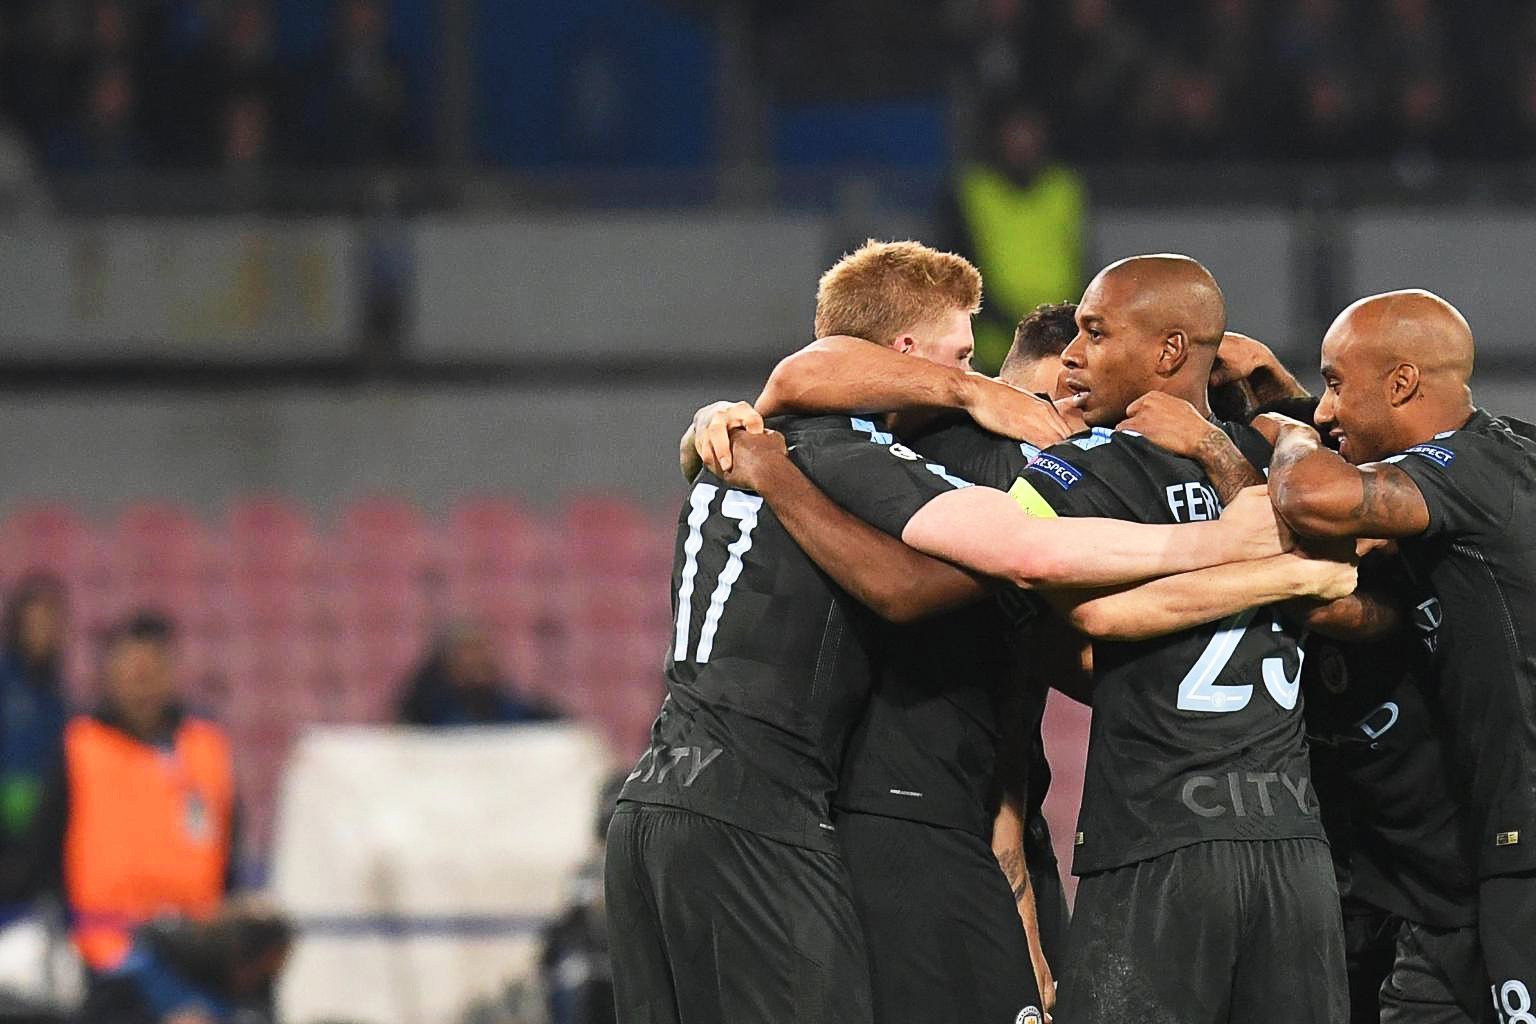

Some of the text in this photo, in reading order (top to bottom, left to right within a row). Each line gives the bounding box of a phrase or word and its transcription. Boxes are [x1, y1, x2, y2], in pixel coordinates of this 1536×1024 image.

[1033, 457, 1078, 485] RESPECT
[673, 483, 764, 664] 17
[1181, 771, 1314, 818] CITY
